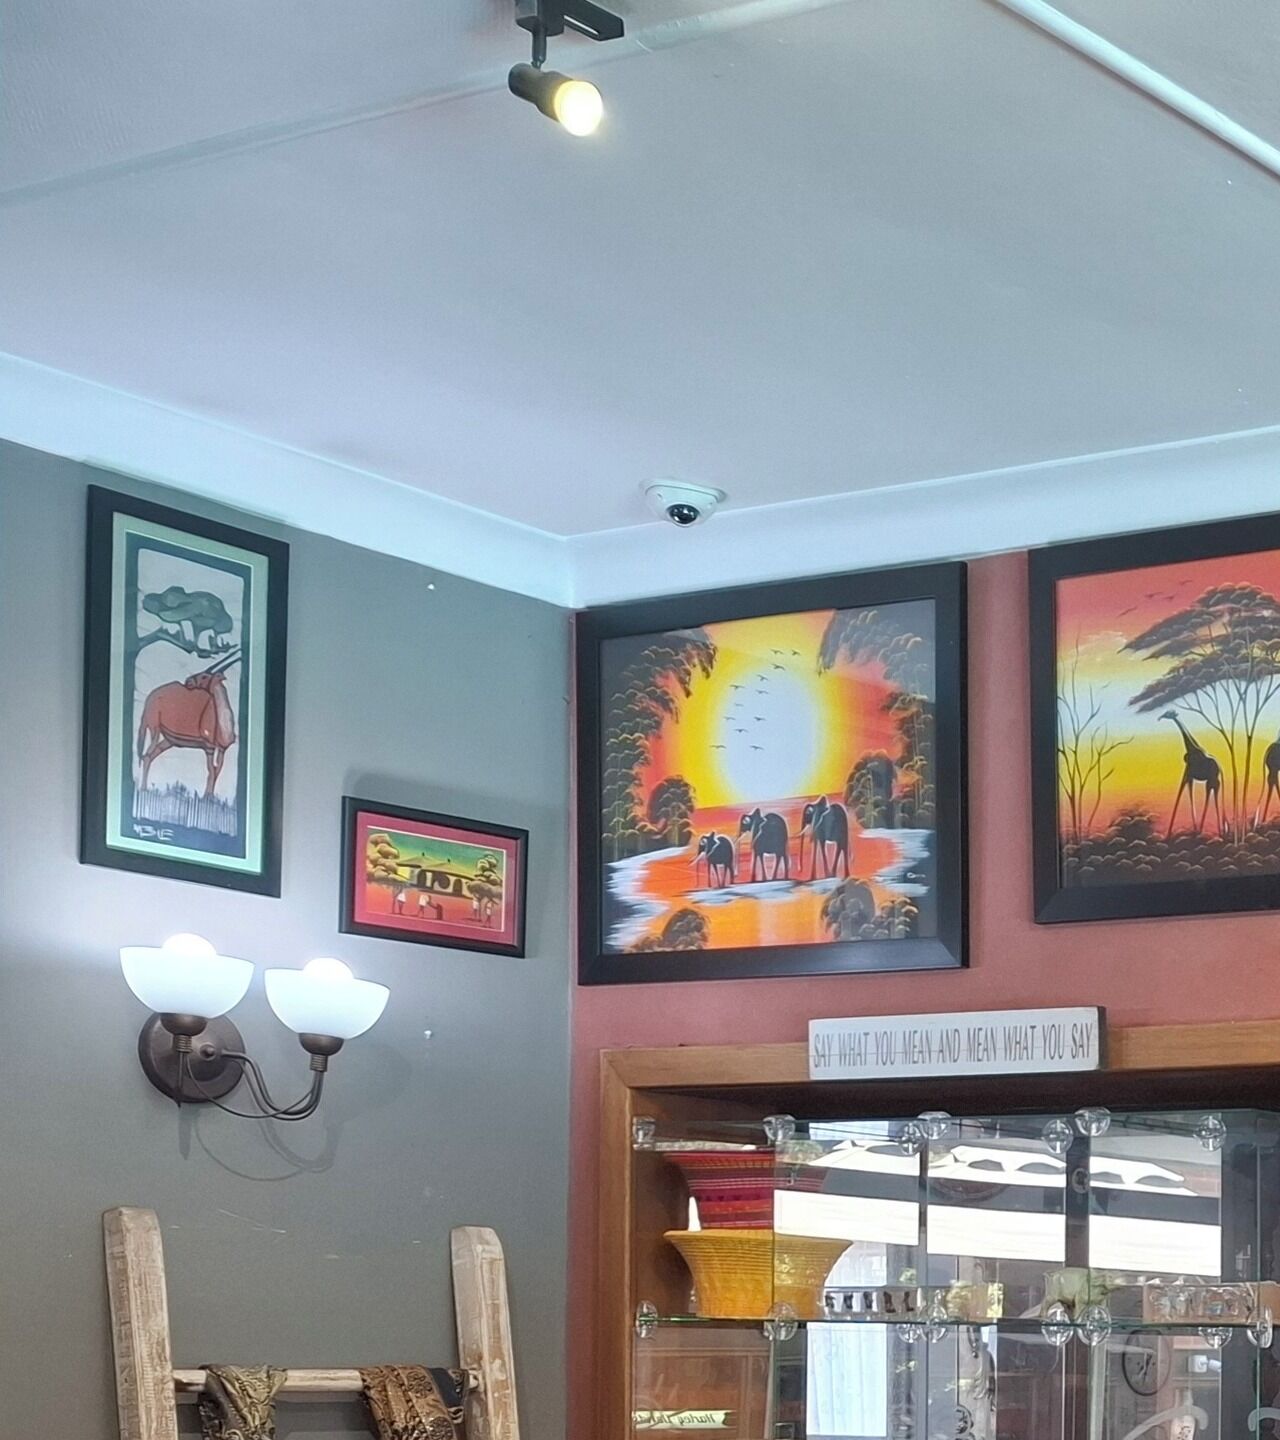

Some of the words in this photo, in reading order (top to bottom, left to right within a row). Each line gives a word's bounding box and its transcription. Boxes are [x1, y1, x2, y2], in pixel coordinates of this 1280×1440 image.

[814, 1034, 832, 1068] SAY
[838, 1031, 870, 1067] WHAT
[875, 1030, 897, 1066] YOU
[901, 1029, 932, 1065] MEAN
[937, 1027, 960, 1063] AND
[967, 1026, 997, 1062] MEAN
[1003, 1024, 1036, 1062] WHAT
[1042, 1023, 1065, 1060] YOU
[1071, 1022, 1094, 1059] SAY
